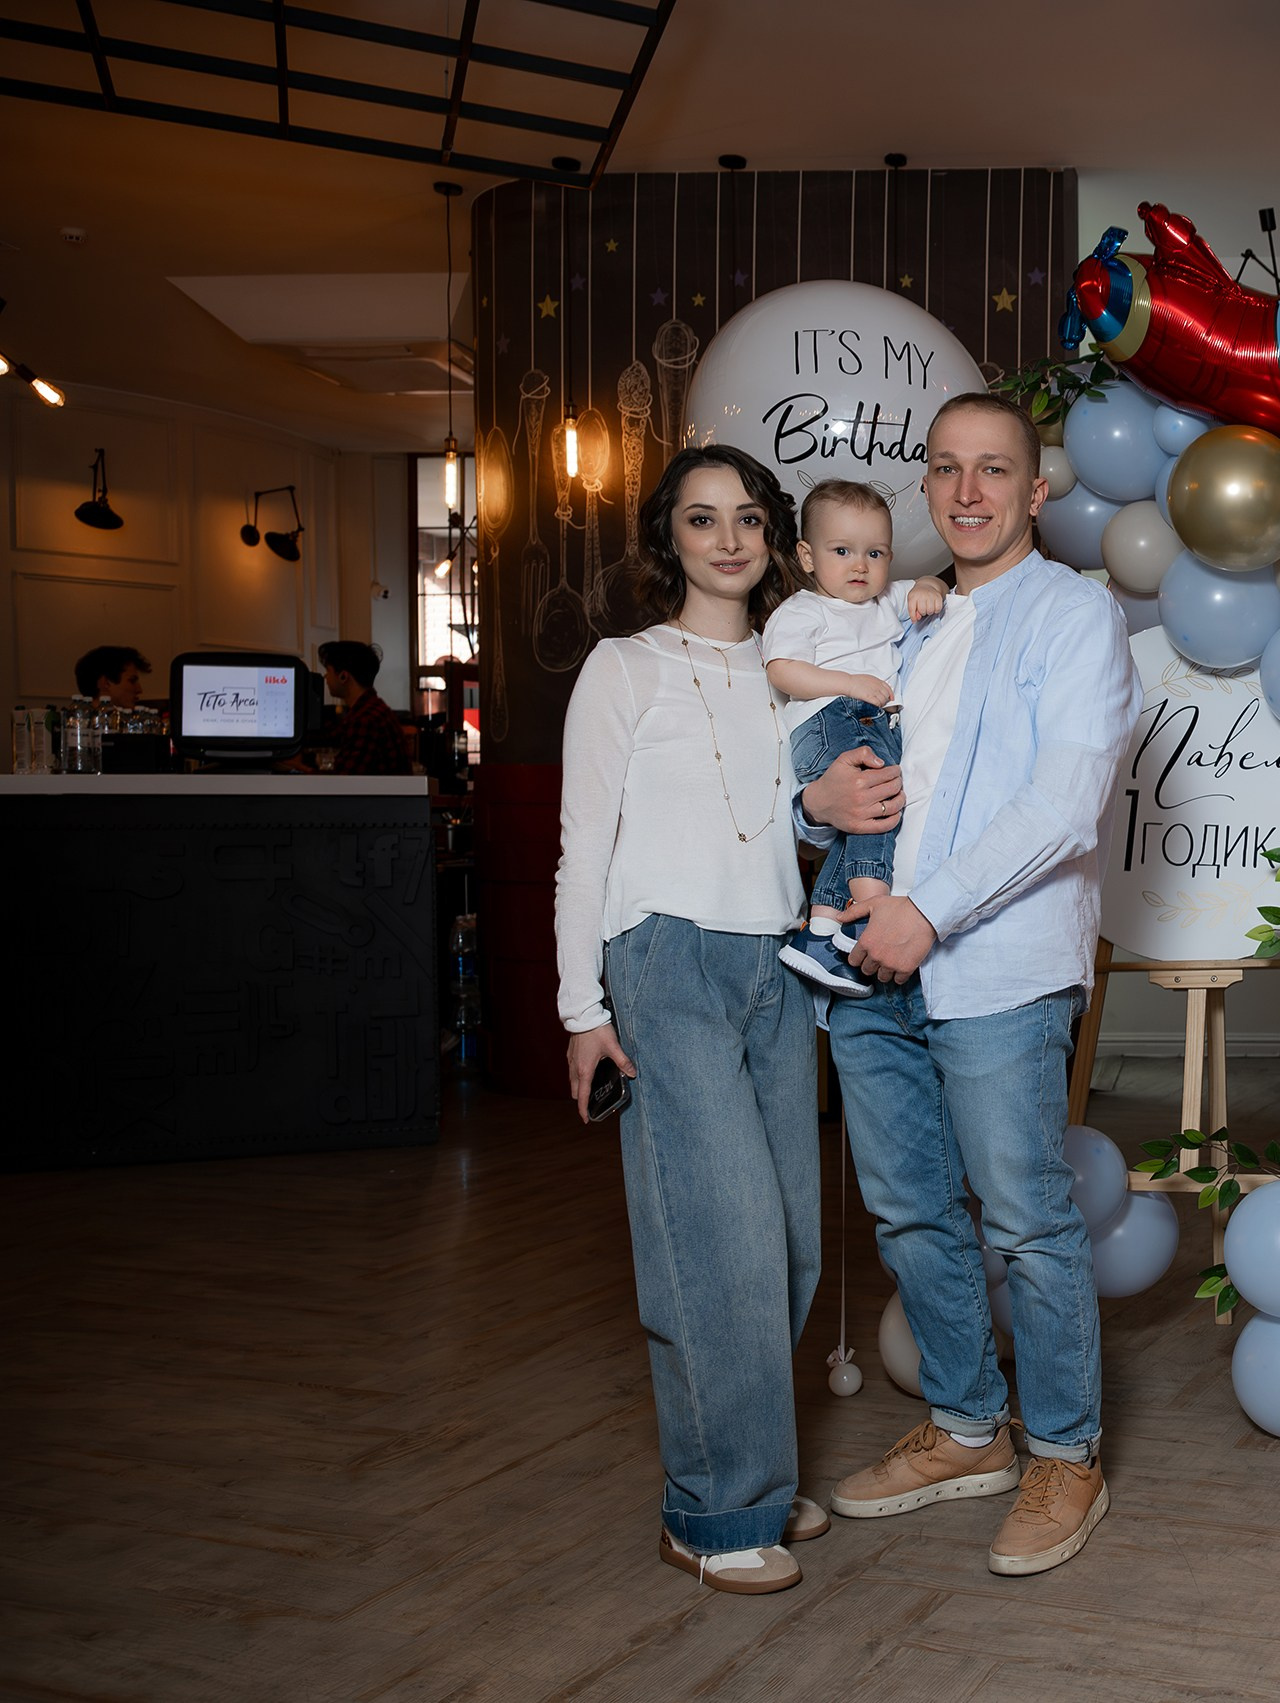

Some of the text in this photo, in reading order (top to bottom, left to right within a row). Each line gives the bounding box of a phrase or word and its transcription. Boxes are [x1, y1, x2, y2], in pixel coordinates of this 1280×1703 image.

[794, 329, 935, 390] IT'S MY
[761, 393, 928, 466] Birthda
[1123, 788, 1277, 879] 1 ГОДИК
